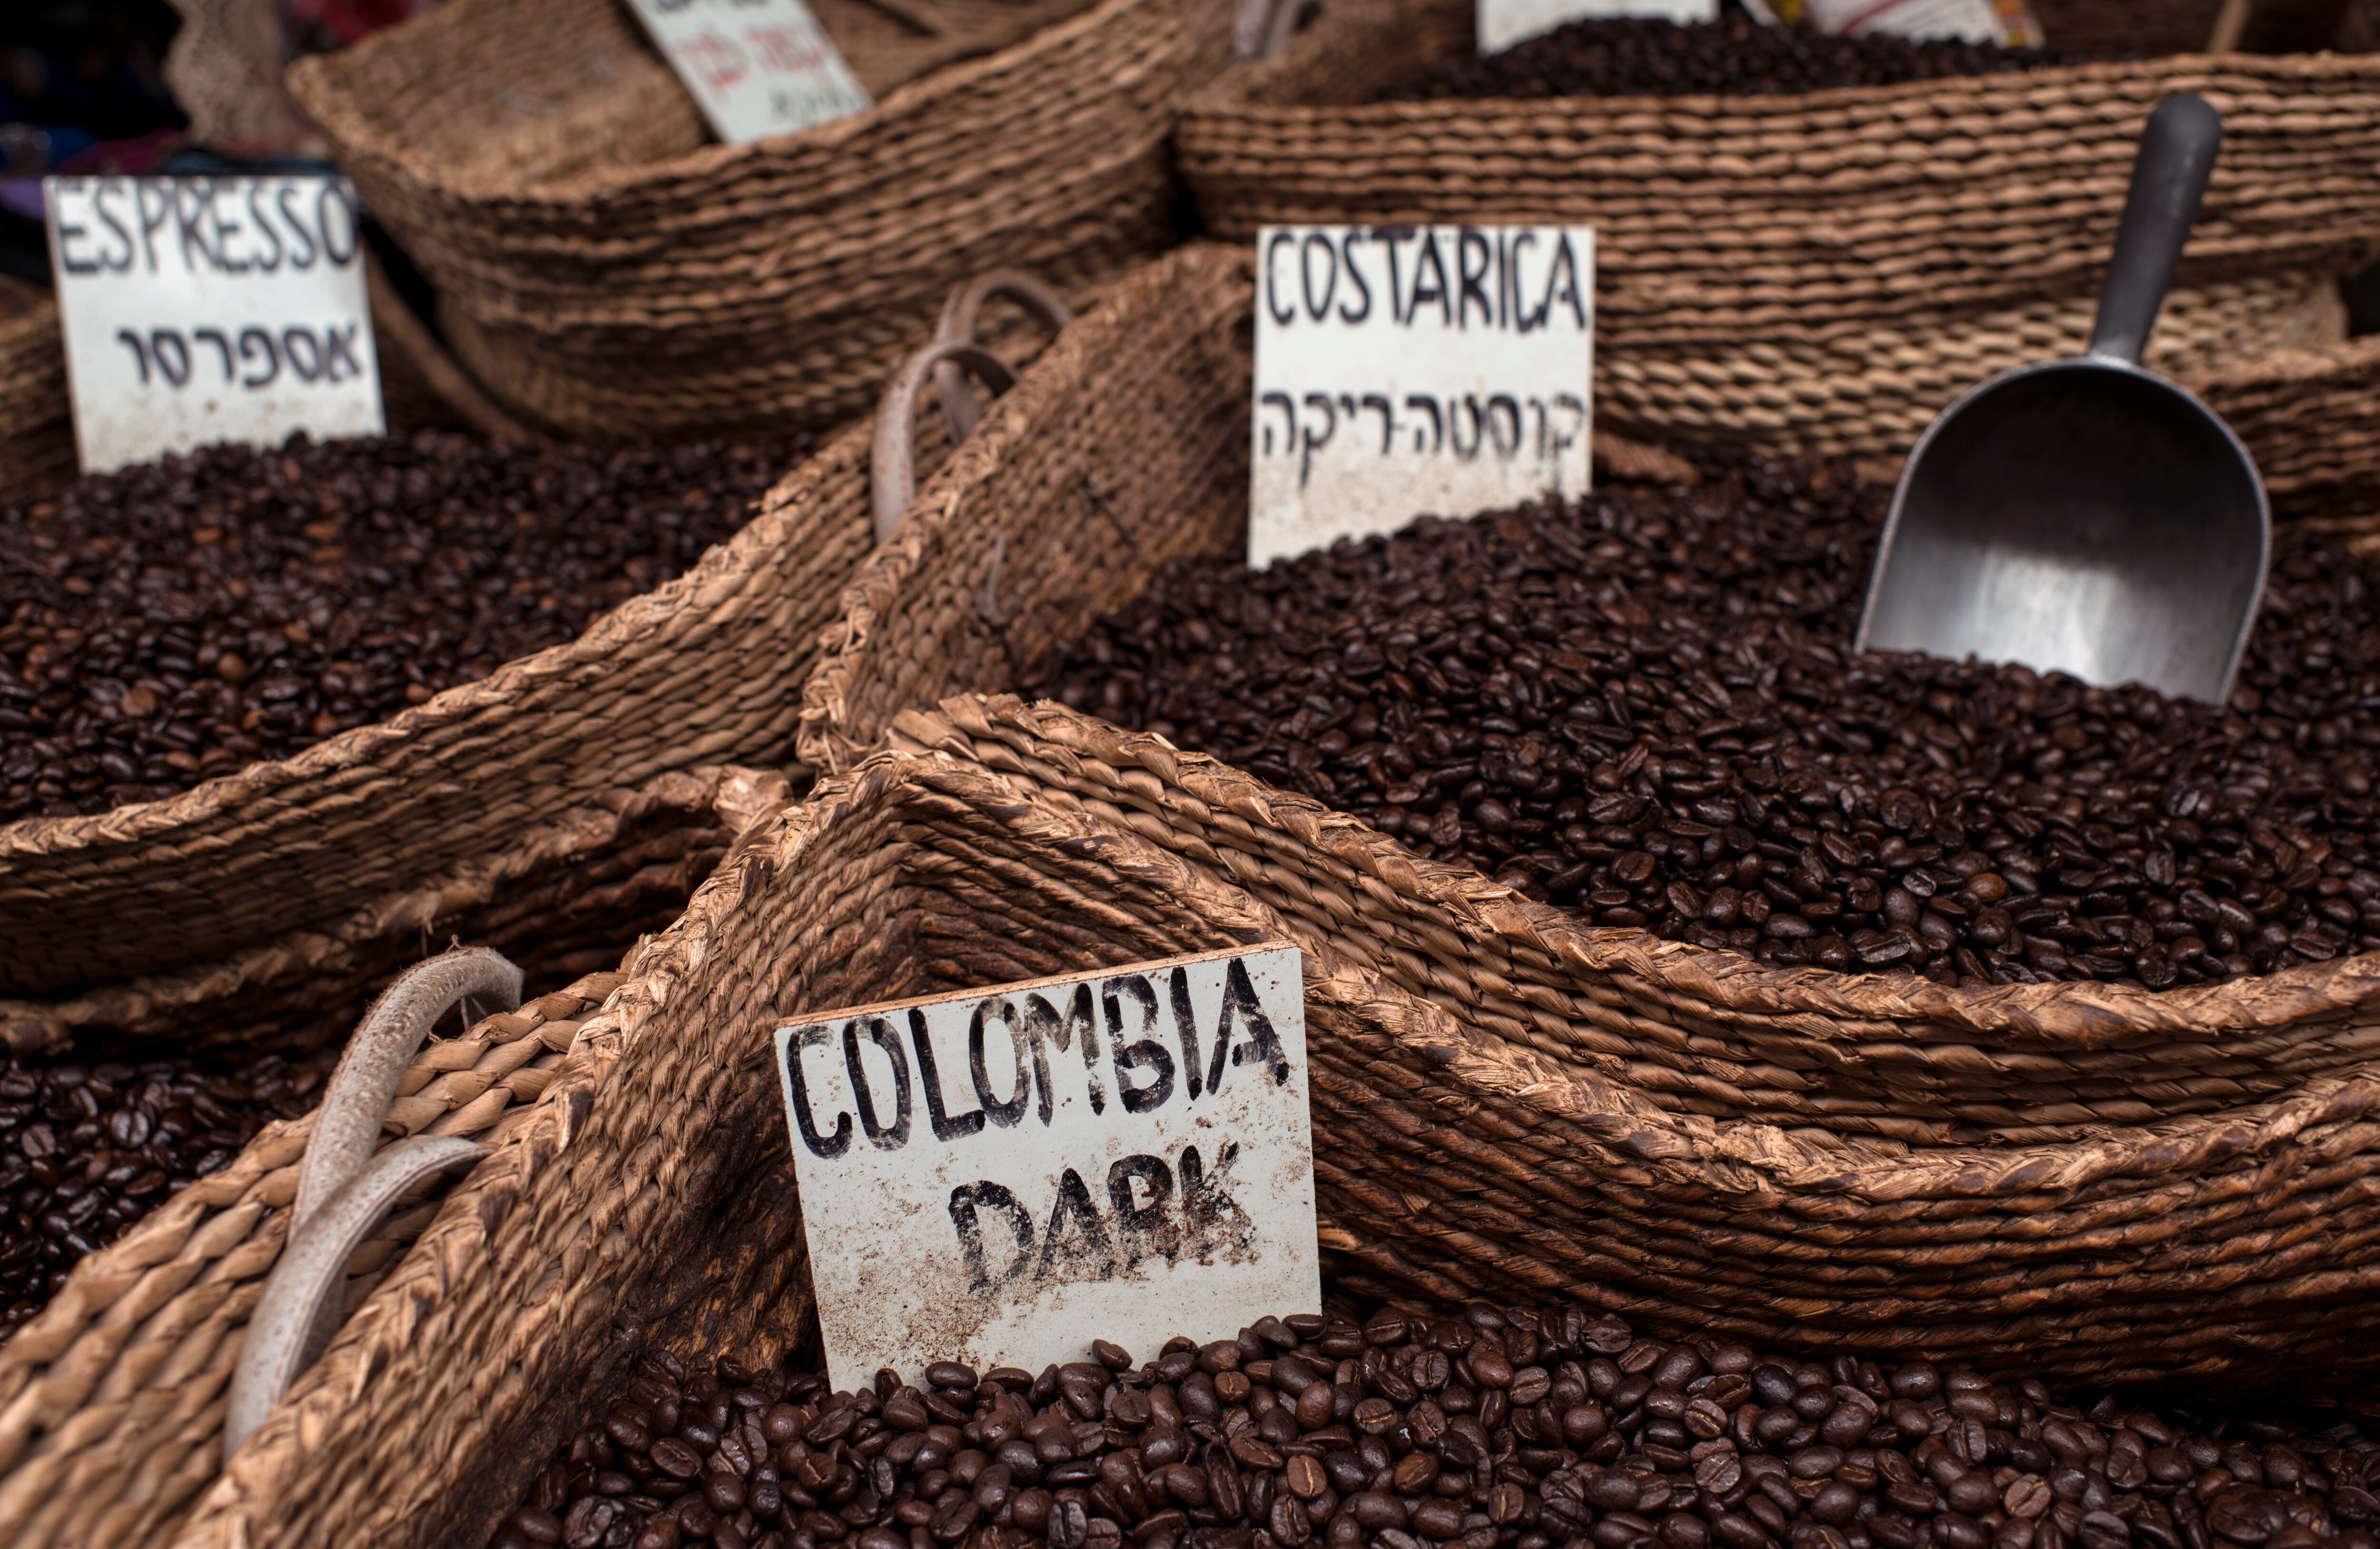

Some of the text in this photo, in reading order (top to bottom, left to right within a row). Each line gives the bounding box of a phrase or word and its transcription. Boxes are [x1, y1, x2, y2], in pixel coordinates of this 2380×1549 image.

[53, 177, 358, 274] ESPRESSO
[117, 323, 362, 390] אספרסו
[785, 957, 1291, 1160] COLOMBIA
[948, 1142, 1257, 1294] DARK
